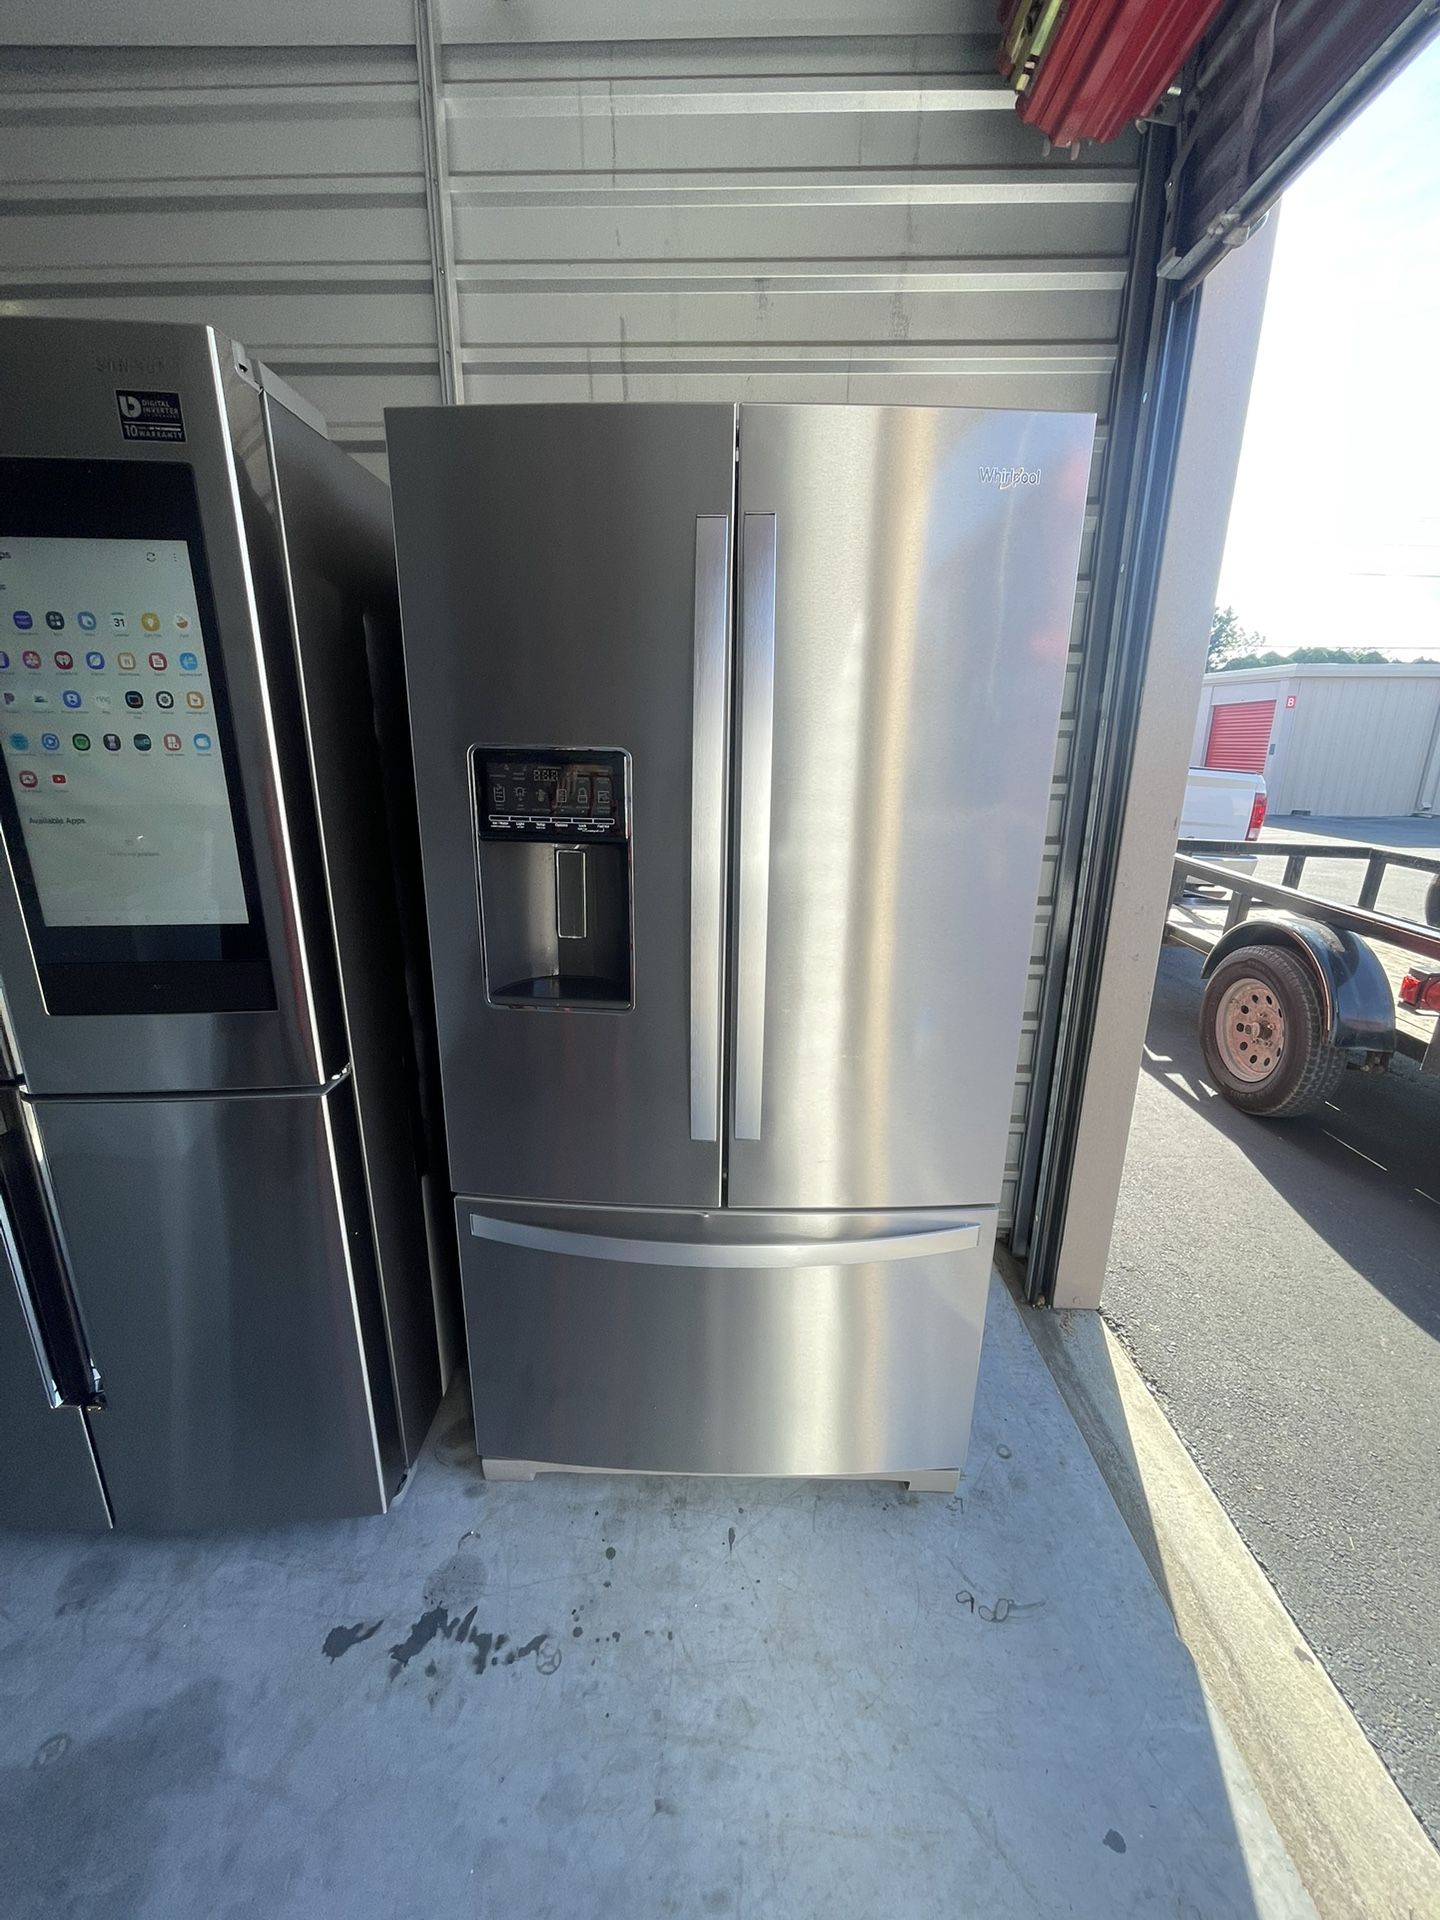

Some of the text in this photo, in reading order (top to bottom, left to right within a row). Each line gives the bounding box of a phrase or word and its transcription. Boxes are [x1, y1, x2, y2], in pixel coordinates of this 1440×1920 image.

[141, 399, 171, 408] DIGITAL
[142, 407, 179, 415] INVERTER
[124, 425, 138, 437] 10
[139, 430, 183, 439] WARRANTY
[979, 466, 1041, 490] Whirlpool
[113, 618, 125, 628] 31
